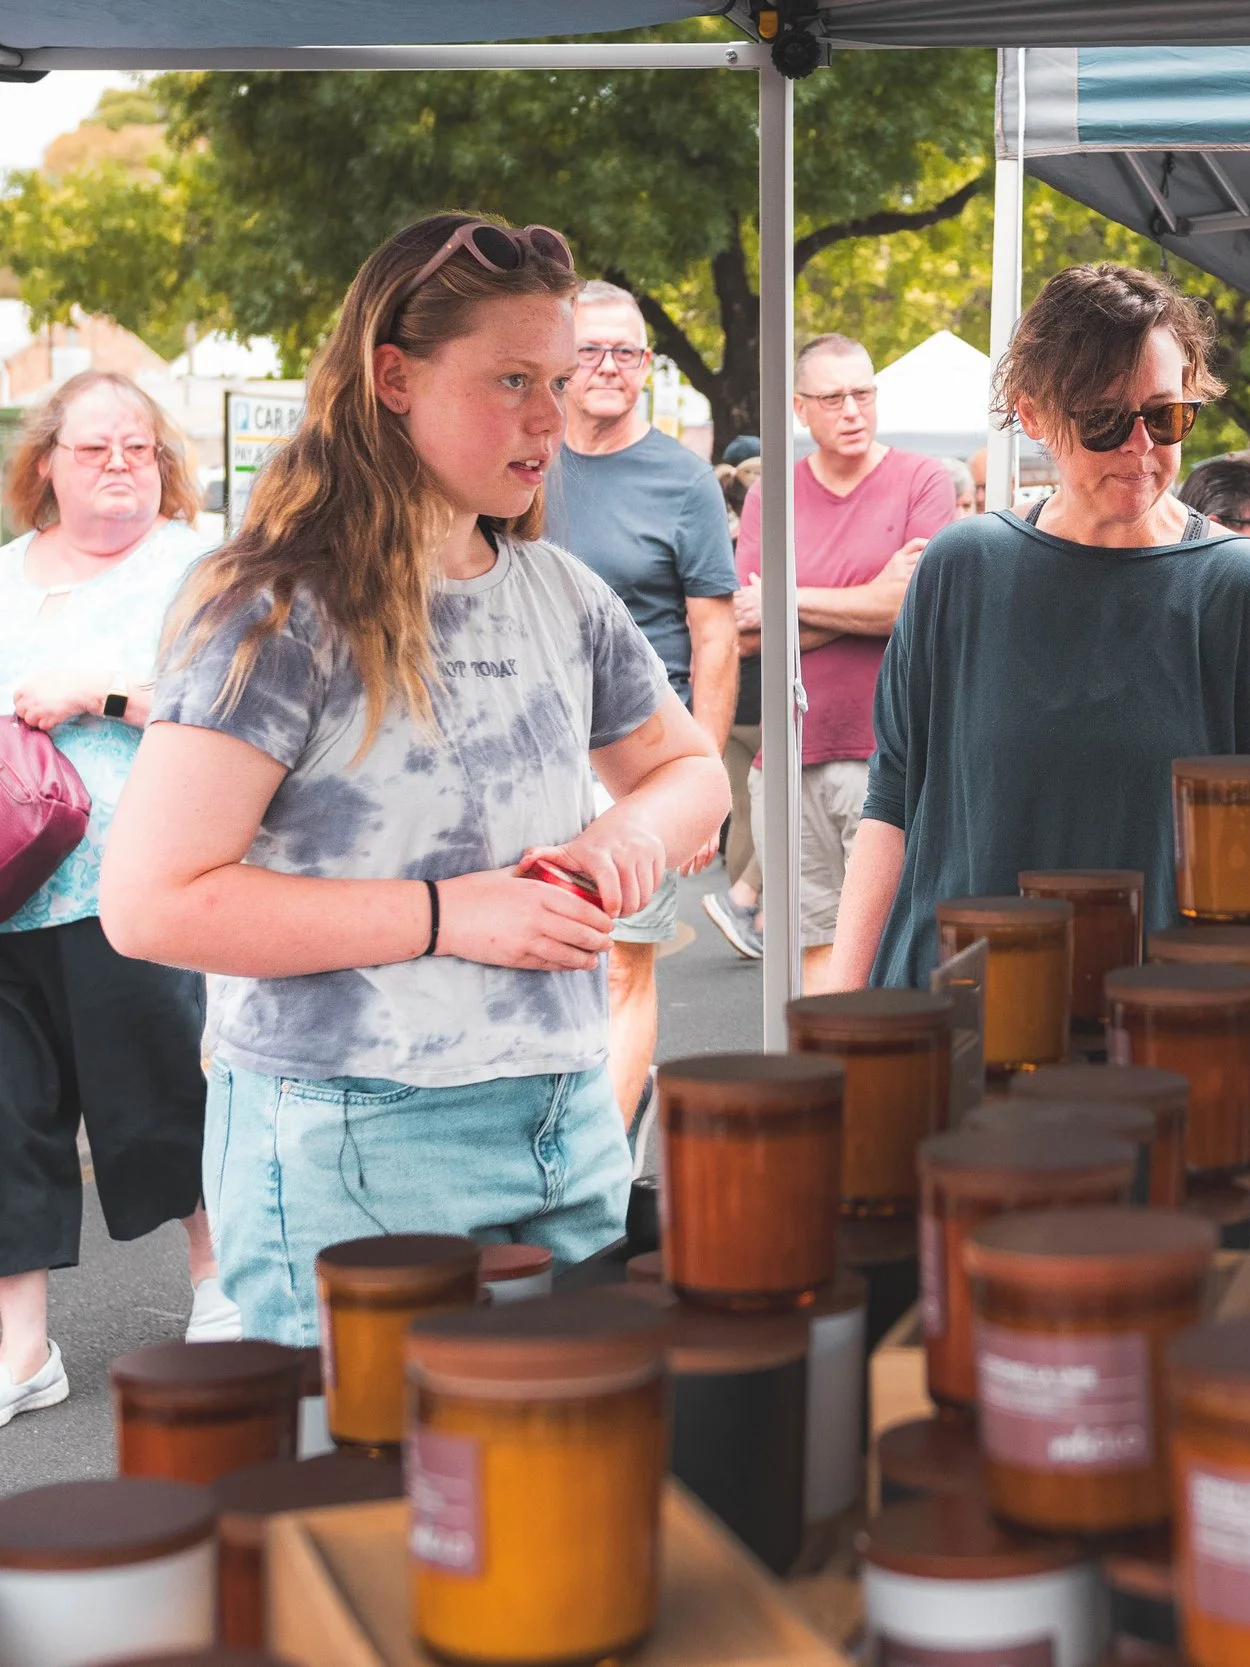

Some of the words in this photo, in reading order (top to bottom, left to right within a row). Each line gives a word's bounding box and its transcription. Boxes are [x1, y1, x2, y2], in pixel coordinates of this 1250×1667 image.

[254, 405, 284, 431] CAR
[235, 446, 252, 460] PAY
[470, 658, 518, 678] TODAY
